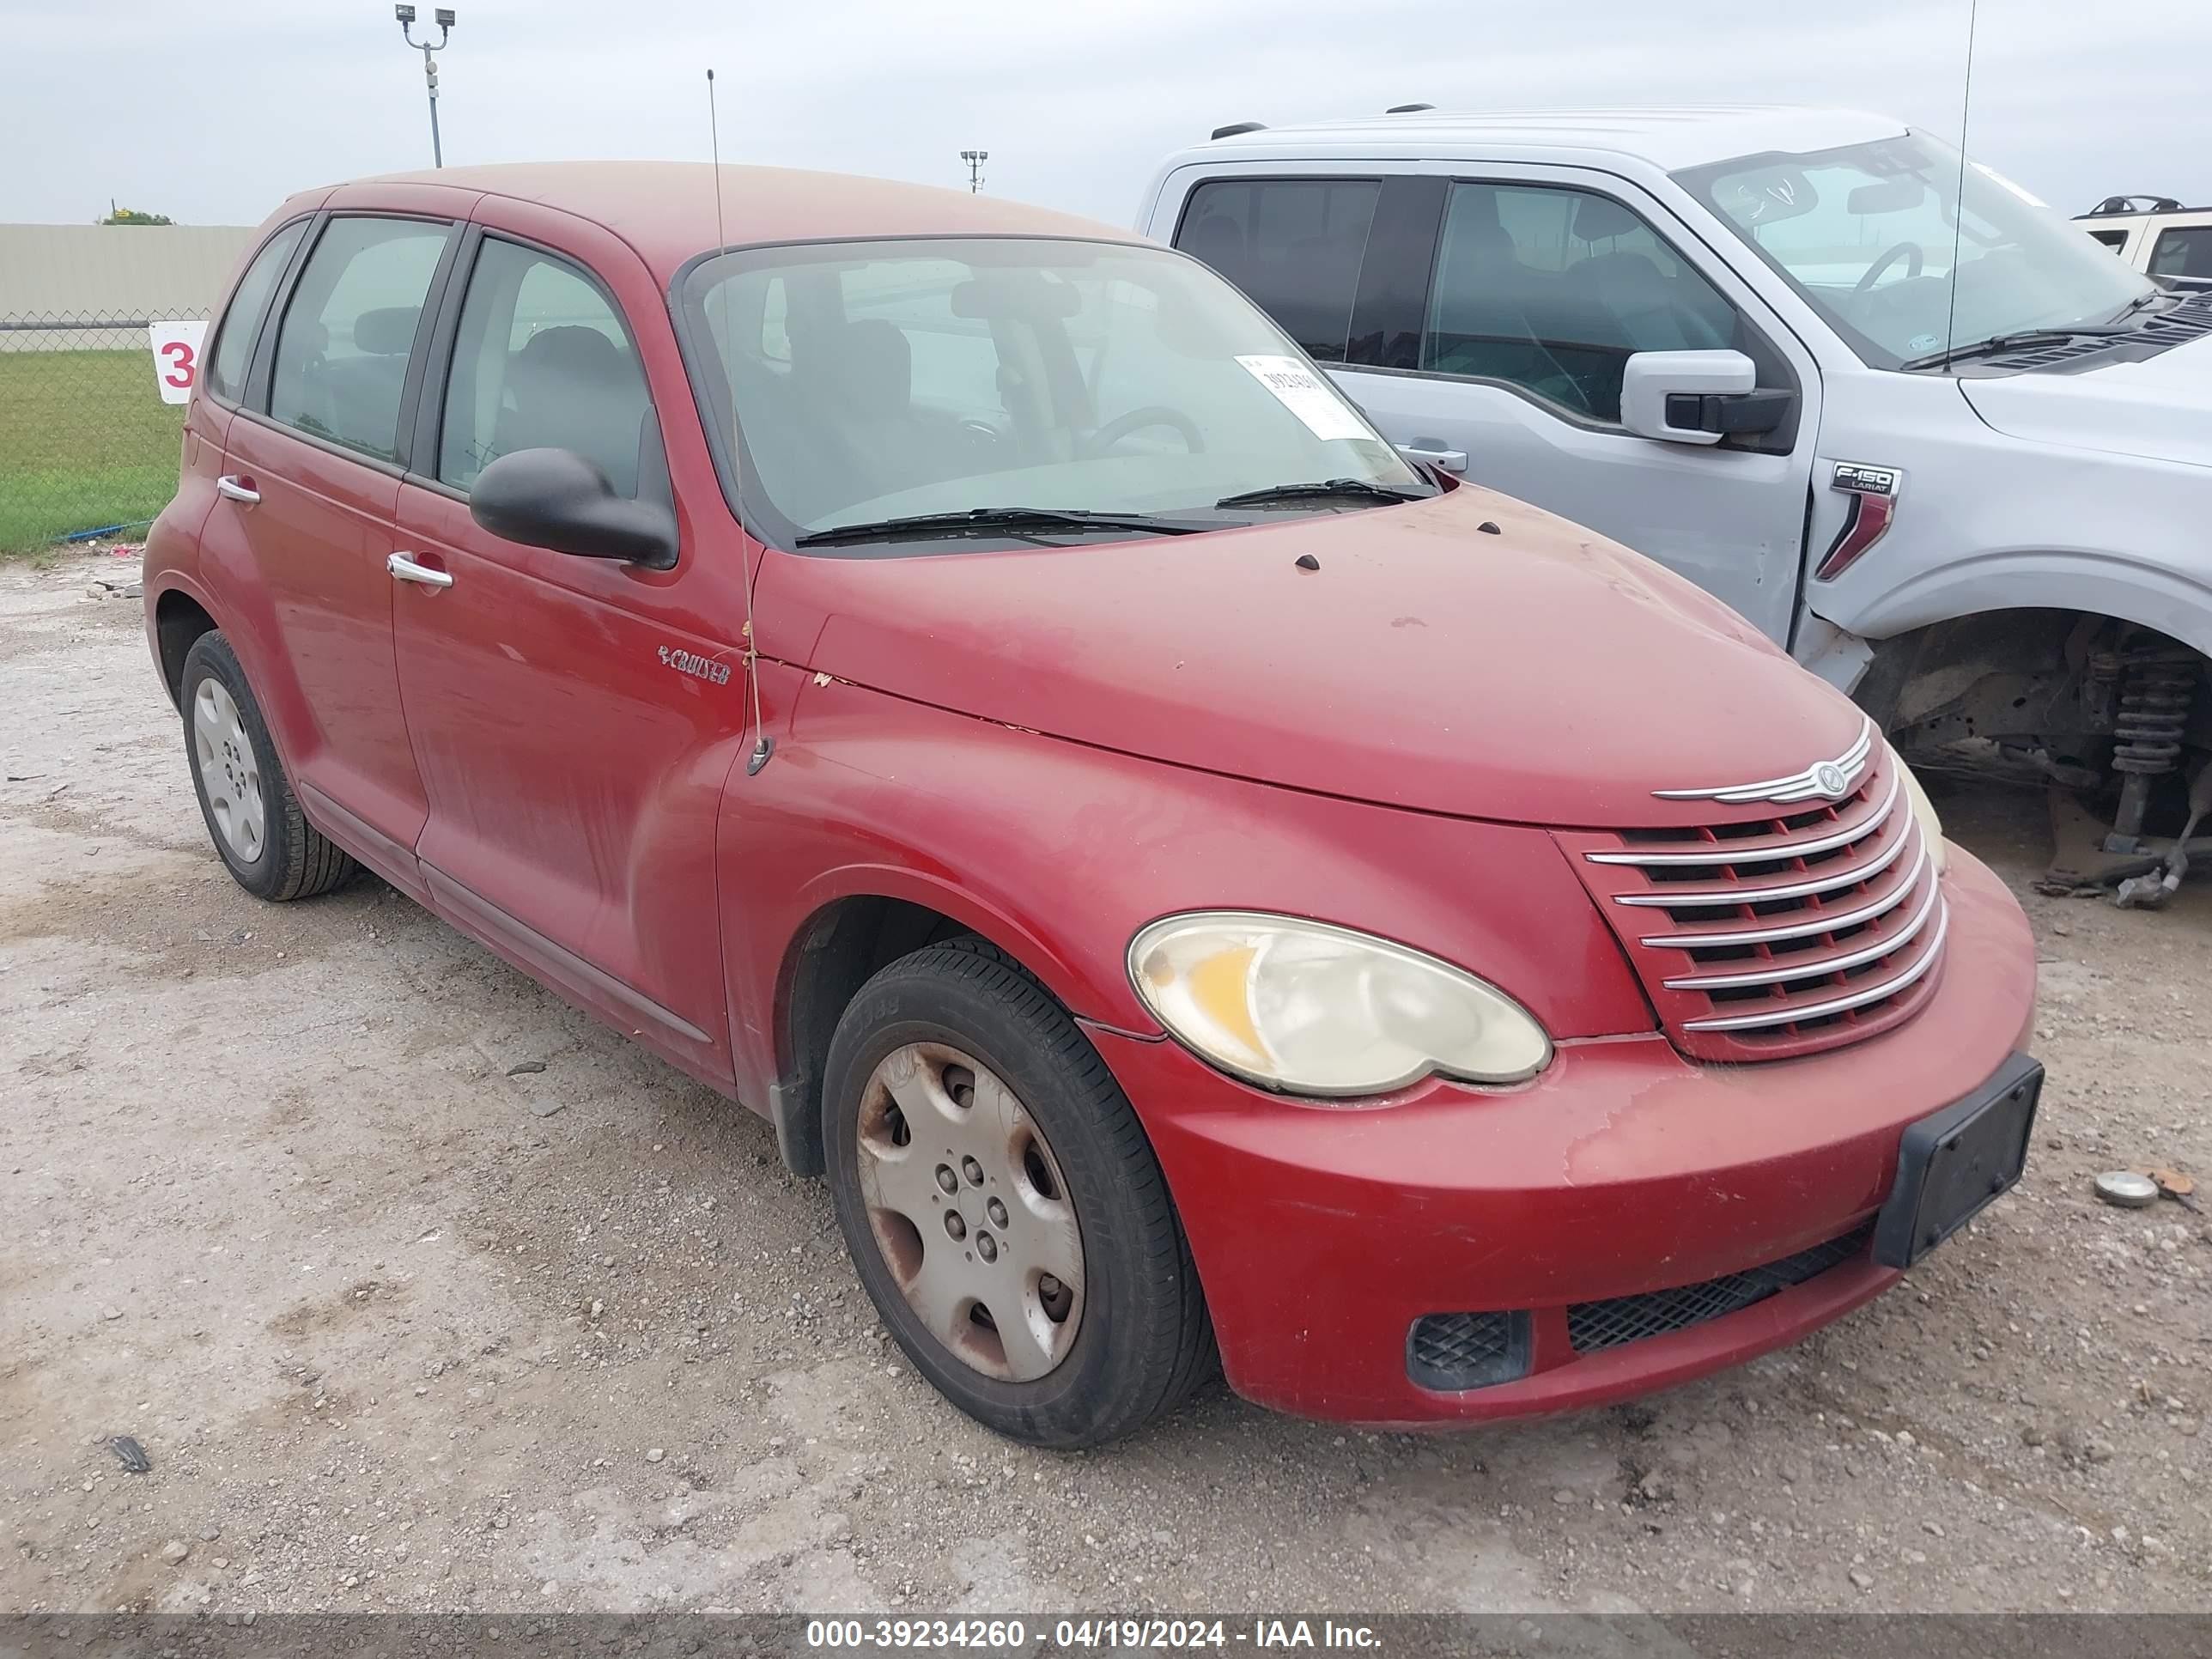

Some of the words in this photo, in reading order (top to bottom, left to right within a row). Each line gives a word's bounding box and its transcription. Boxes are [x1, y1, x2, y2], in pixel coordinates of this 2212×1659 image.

[161, 342, 195, 387] 3
[1852, 482, 1887, 491] LARIAT
[671, 650, 730, 684] CRUISER
